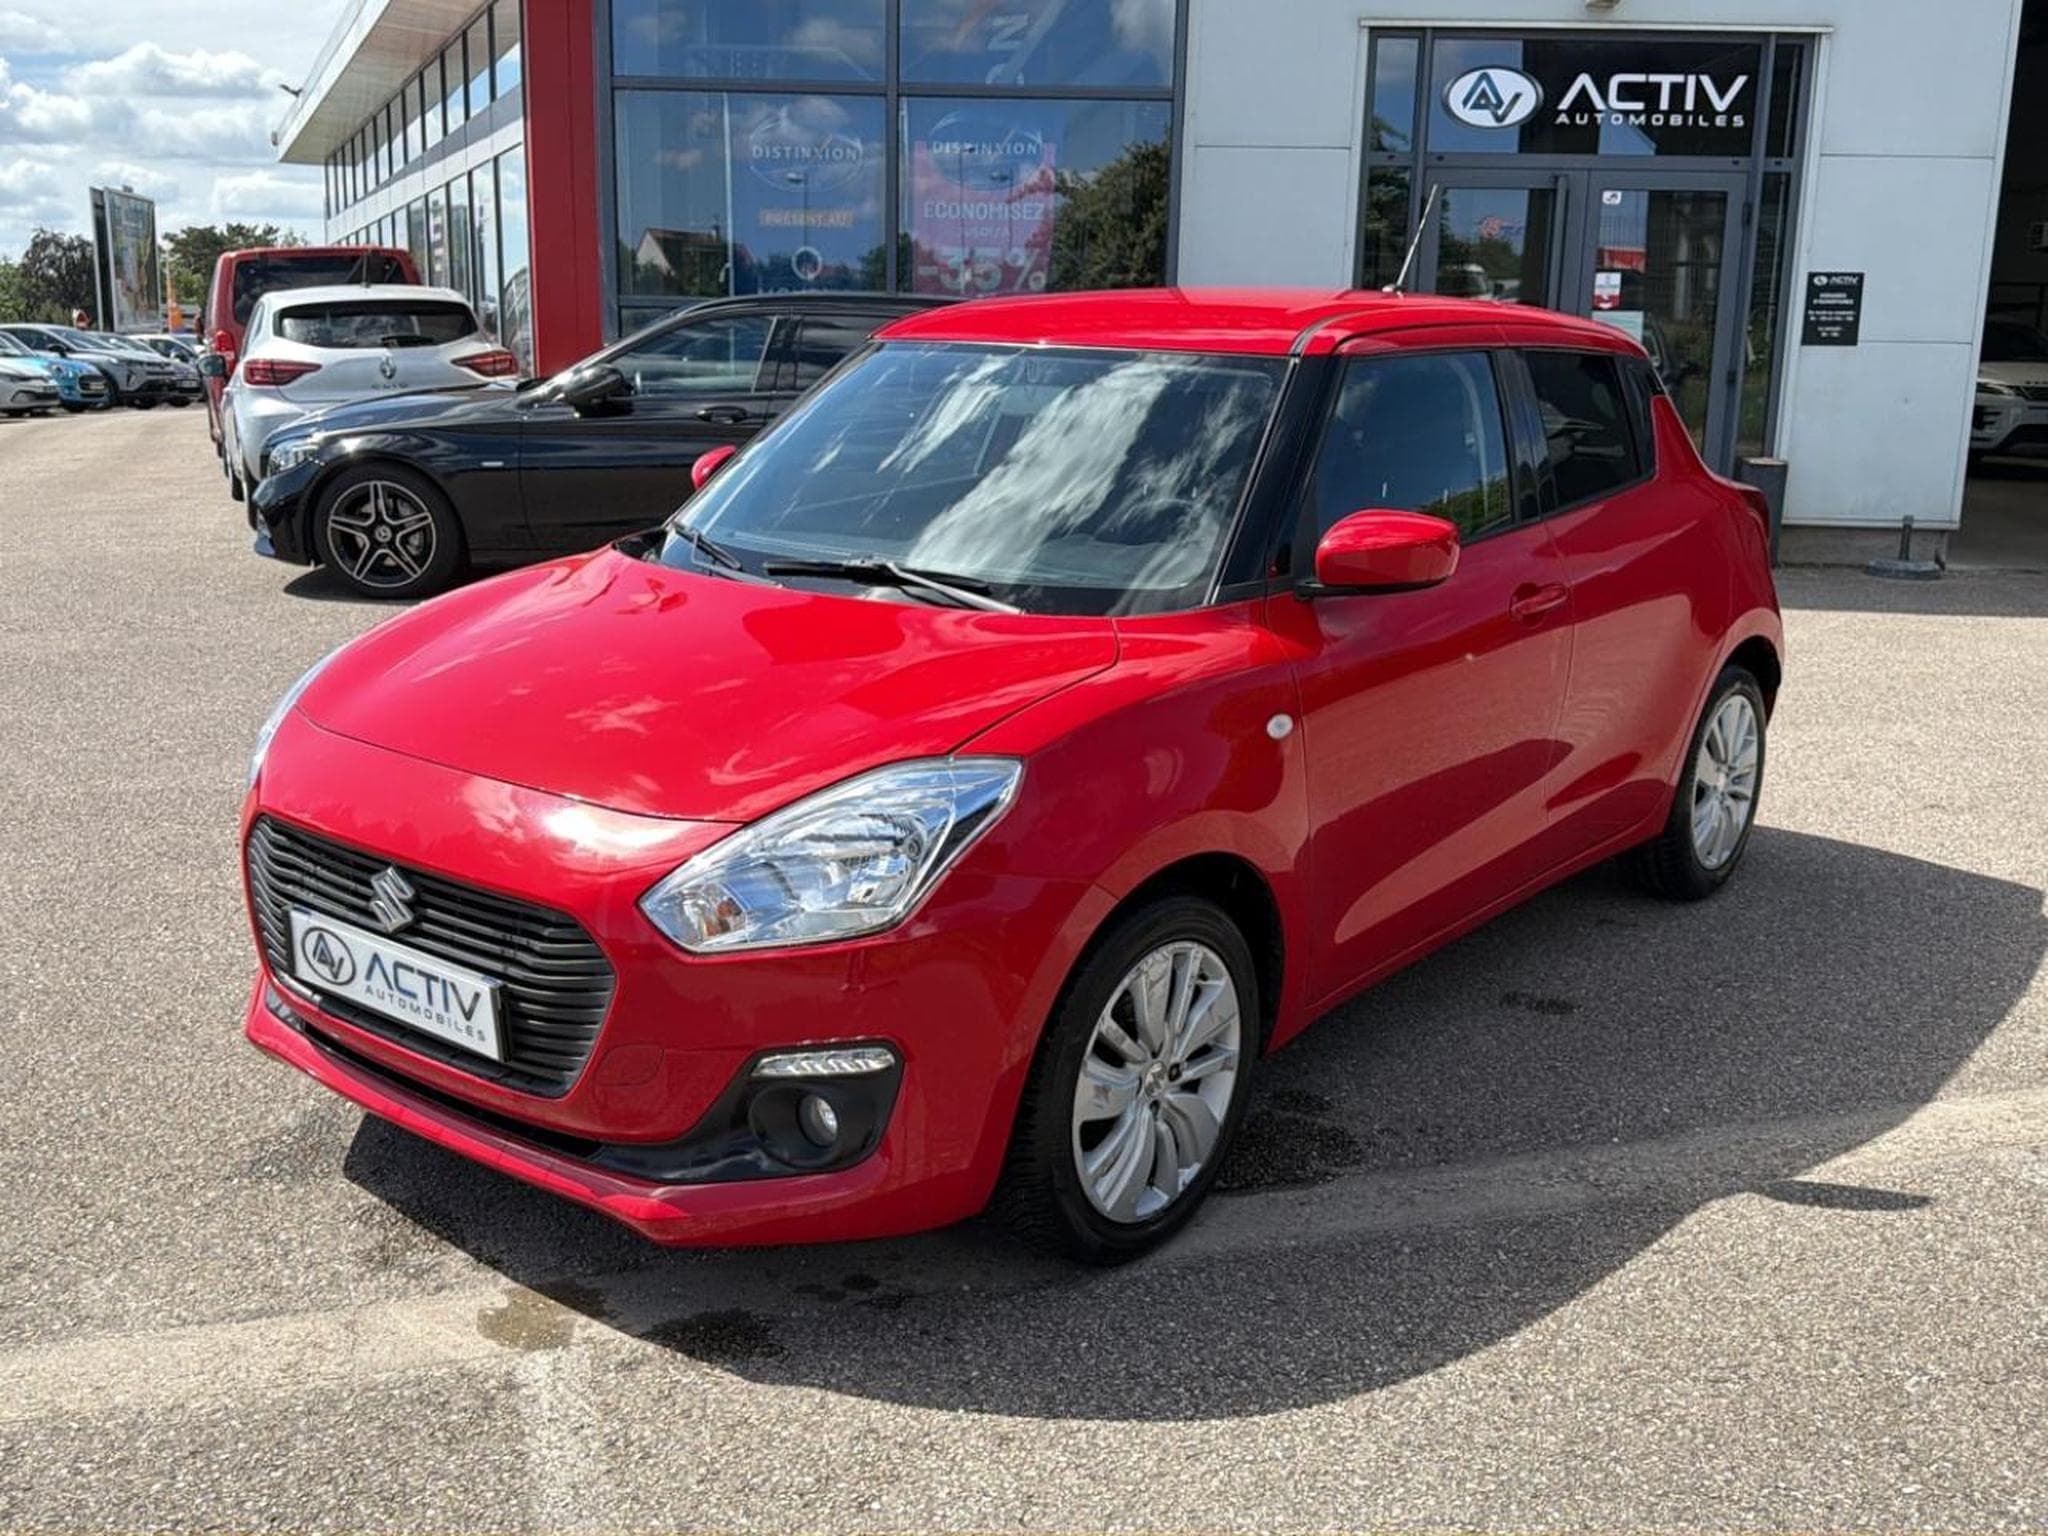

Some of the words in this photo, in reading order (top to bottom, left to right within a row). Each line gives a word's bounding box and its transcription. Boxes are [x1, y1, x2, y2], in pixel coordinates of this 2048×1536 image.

[1557, 72, 1748, 112] ACTIV
[1555, 112, 1745, 128] AUTOMOBILES
[365, 952, 480, 1022] ACTIV
[365, 986, 486, 1042] AUTOMOBILES
